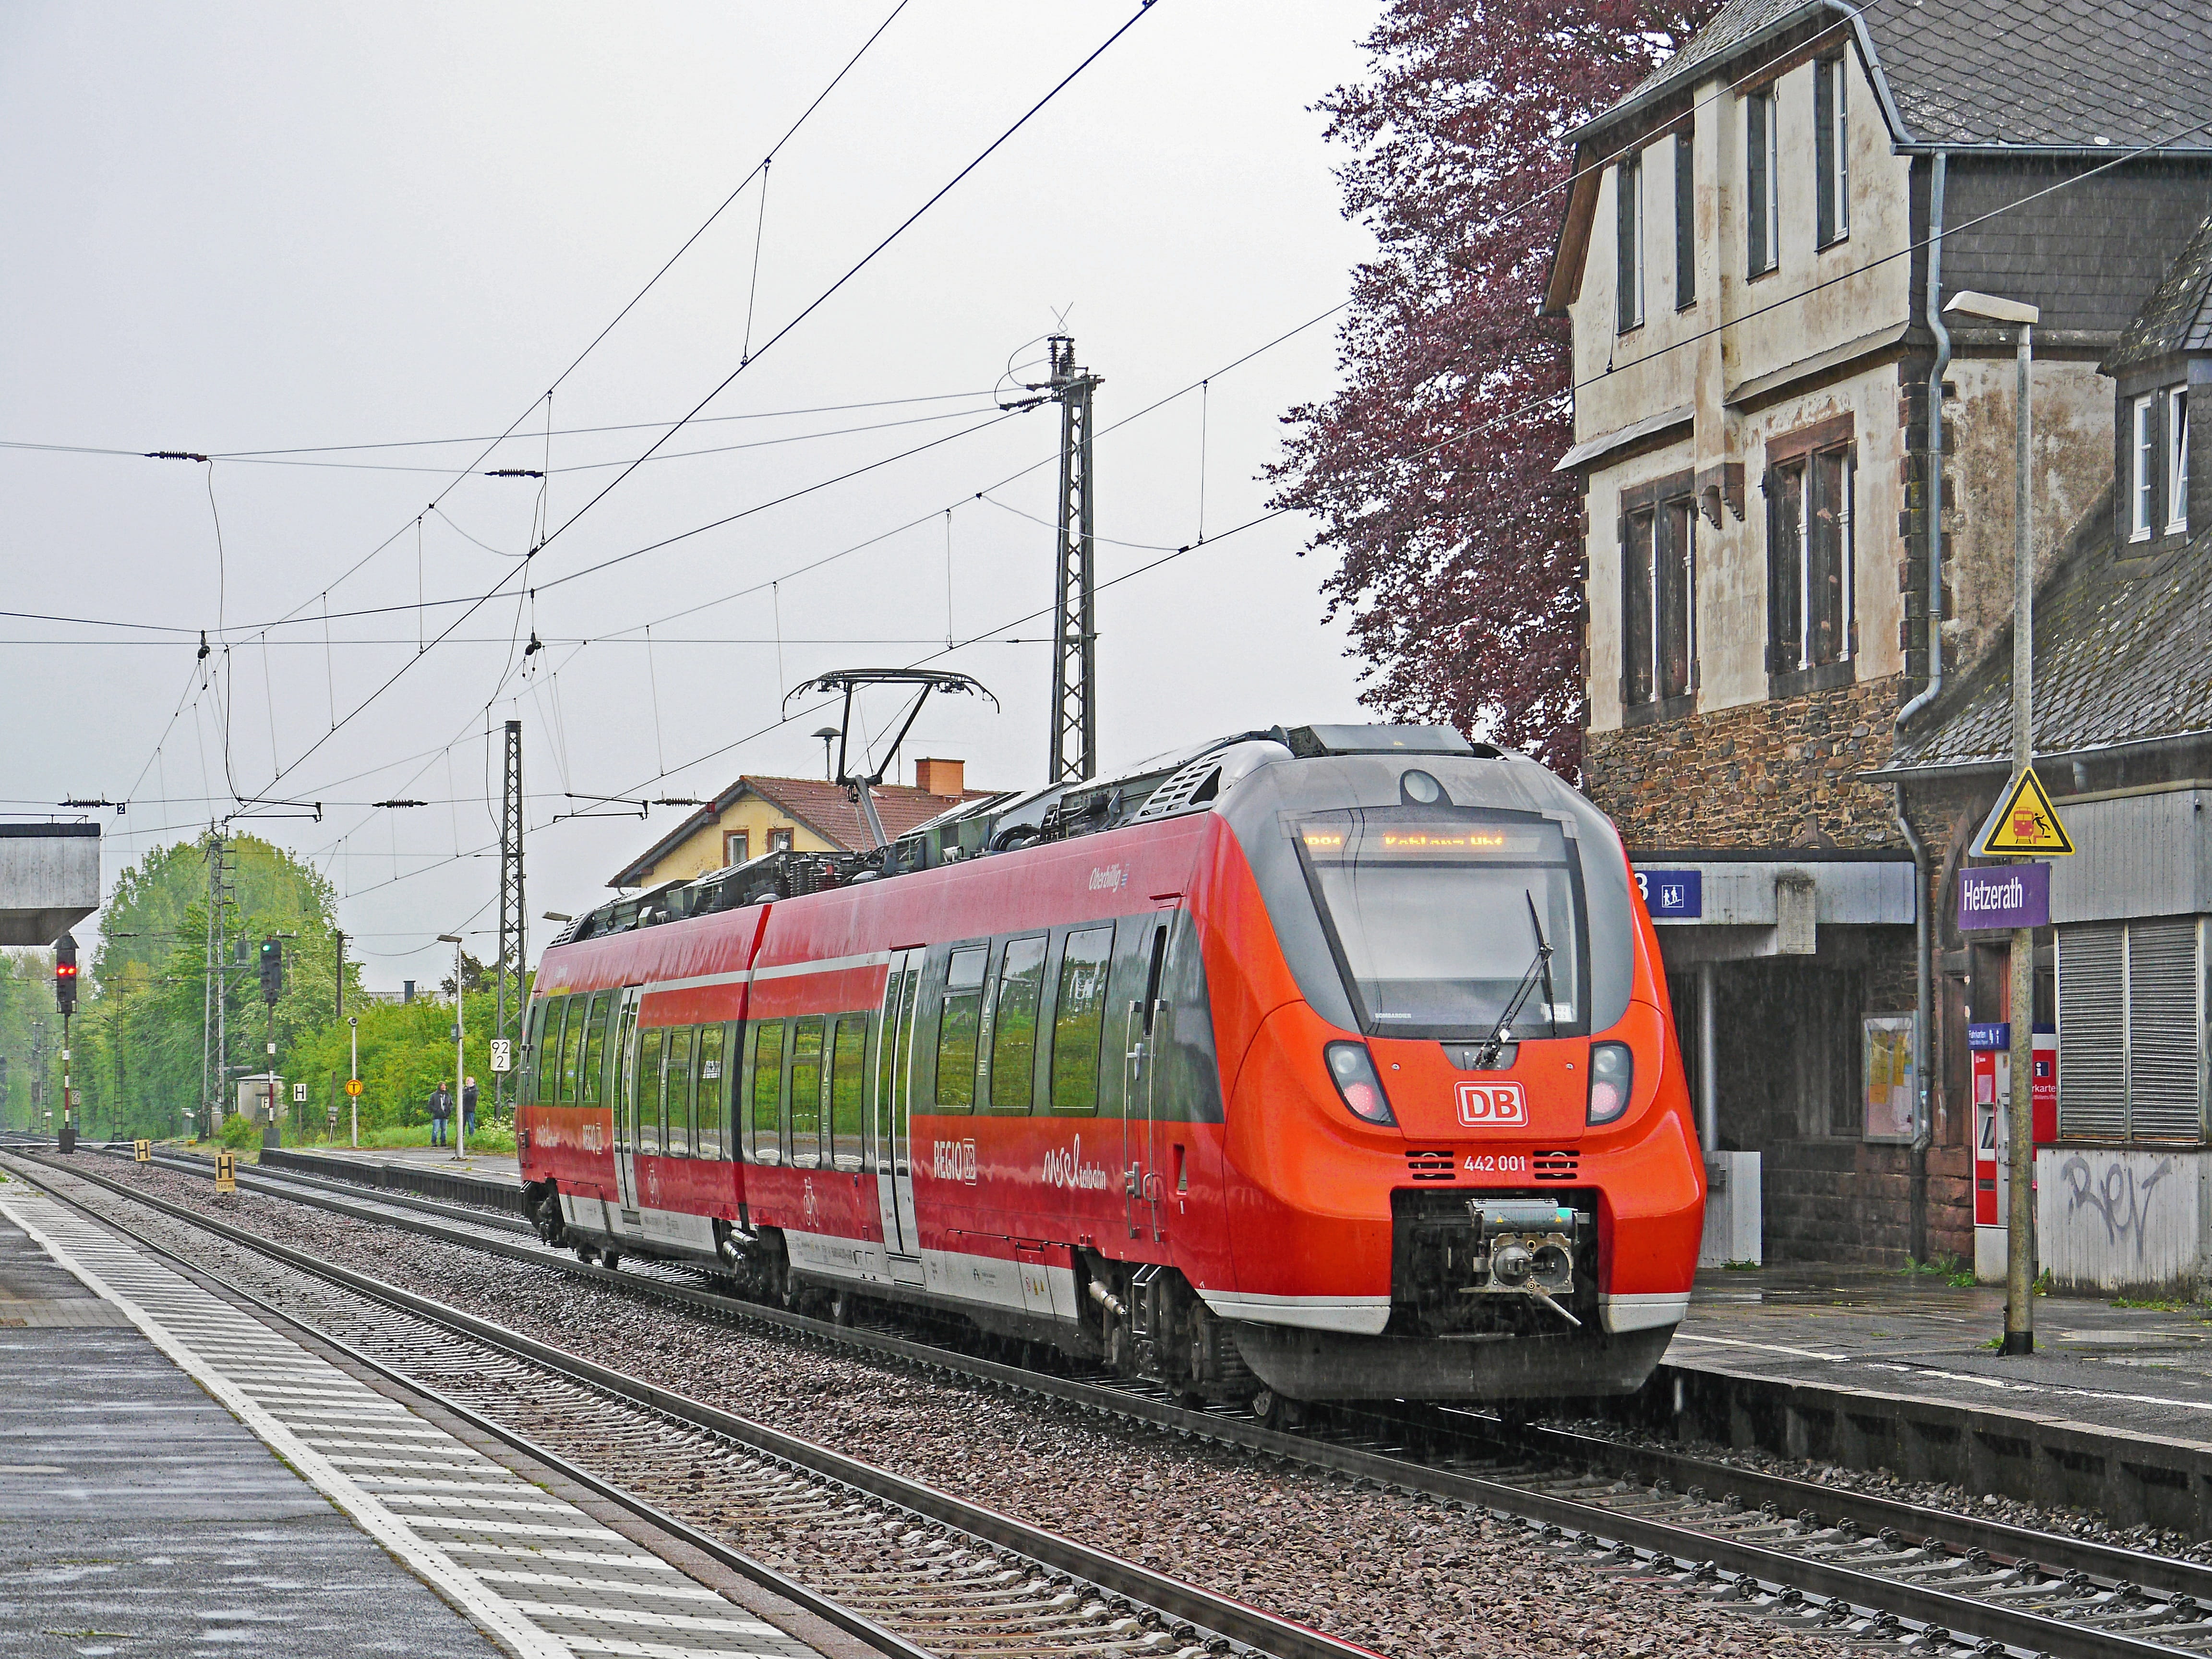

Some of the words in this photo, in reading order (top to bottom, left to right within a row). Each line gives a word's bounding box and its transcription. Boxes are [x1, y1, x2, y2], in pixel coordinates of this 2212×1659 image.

[1088, 864, 1121, 893] Oberbillig
[1963, 876, 2023, 911] Hetzerath
[985, 977, 994, 1013] 2
[492, 1042, 508, 1054] 92
[496, 1055, 504, 1068] 2
[825, 1051, 830, 1082] 2
[264, 1098, 268, 1107] F
[295, 1085, 304, 1099] H
[1465, 1090, 1518, 1118] DB
[137, 1142, 148, 1159] H
[934, 1141, 962, 1181] REGIO
[218, 1156, 232, 1178] H
[1464, 1156, 1494, 1171] 442
[1498, 1156, 1526, 1171] 001
